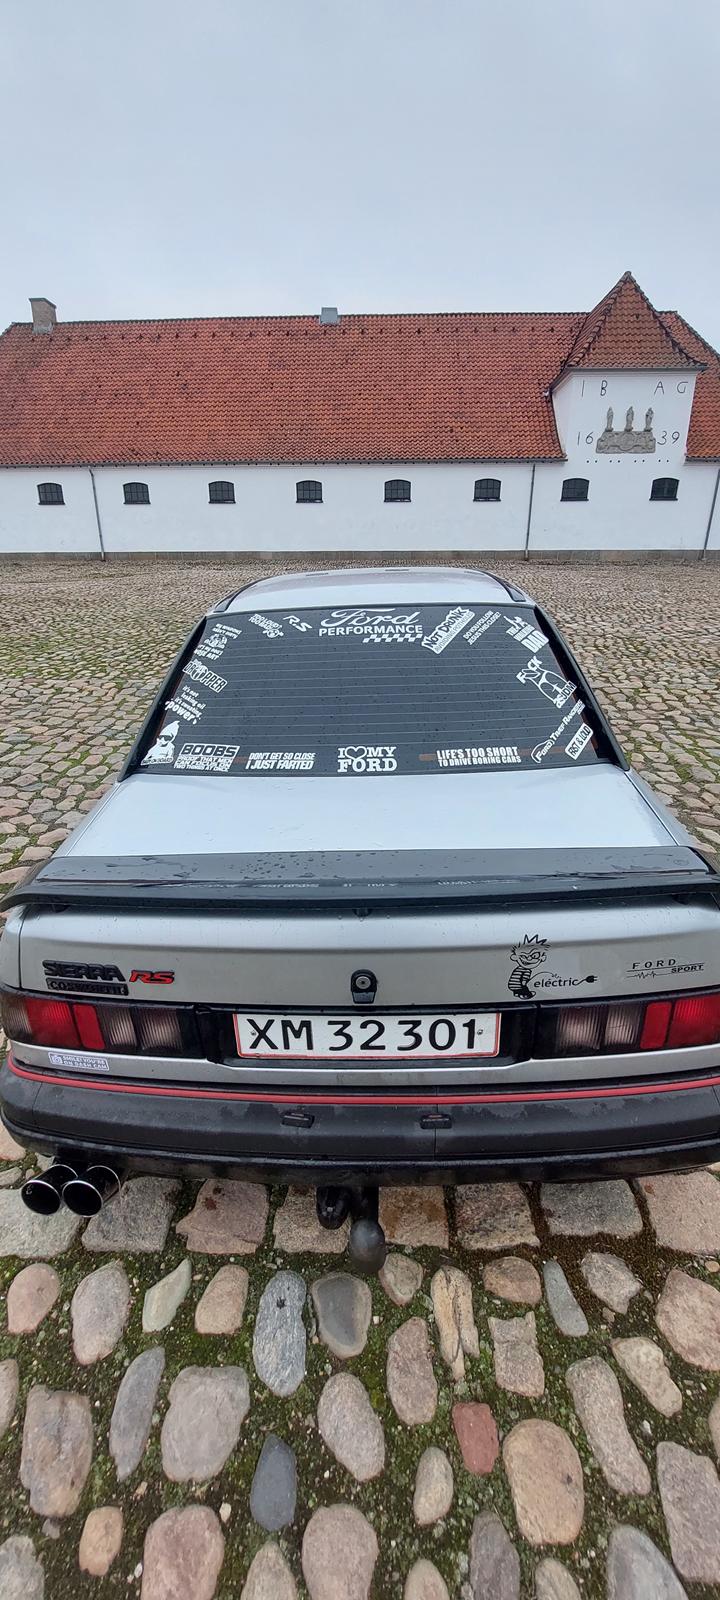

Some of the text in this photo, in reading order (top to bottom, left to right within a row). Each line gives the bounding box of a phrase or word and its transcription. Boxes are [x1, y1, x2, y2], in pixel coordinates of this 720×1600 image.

[282, 615, 313, 632] RS
[320, 608, 420, 627] Ford
[318, 625, 424, 637] PERFORMANCE
[423, 608, 468, 649] NOT DRUNK
[463, 630, 472, 640] DO
[520, 630, 549, 653] DAD
[181, 744, 238, 758] BOOBS
[249, 752, 316, 761] DON'T GET SO CLOSE
[366, 746, 397, 758] MY
[436, 746, 518, 760] LIFE'S TOO SHORT
[250, 759, 278, 770] JUST
[276, 759, 315, 770] FARTED
[337, 758, 398, 773] FORD
[438, 755, 522, 767] TO DRIVE BORING CARS
[632, 958, 677, 970] FORD
[671, 964, 704, 974] SPORT
[129, 970, 175, 984] RS
[246, 1018, 476, 1051] XM 32 301
